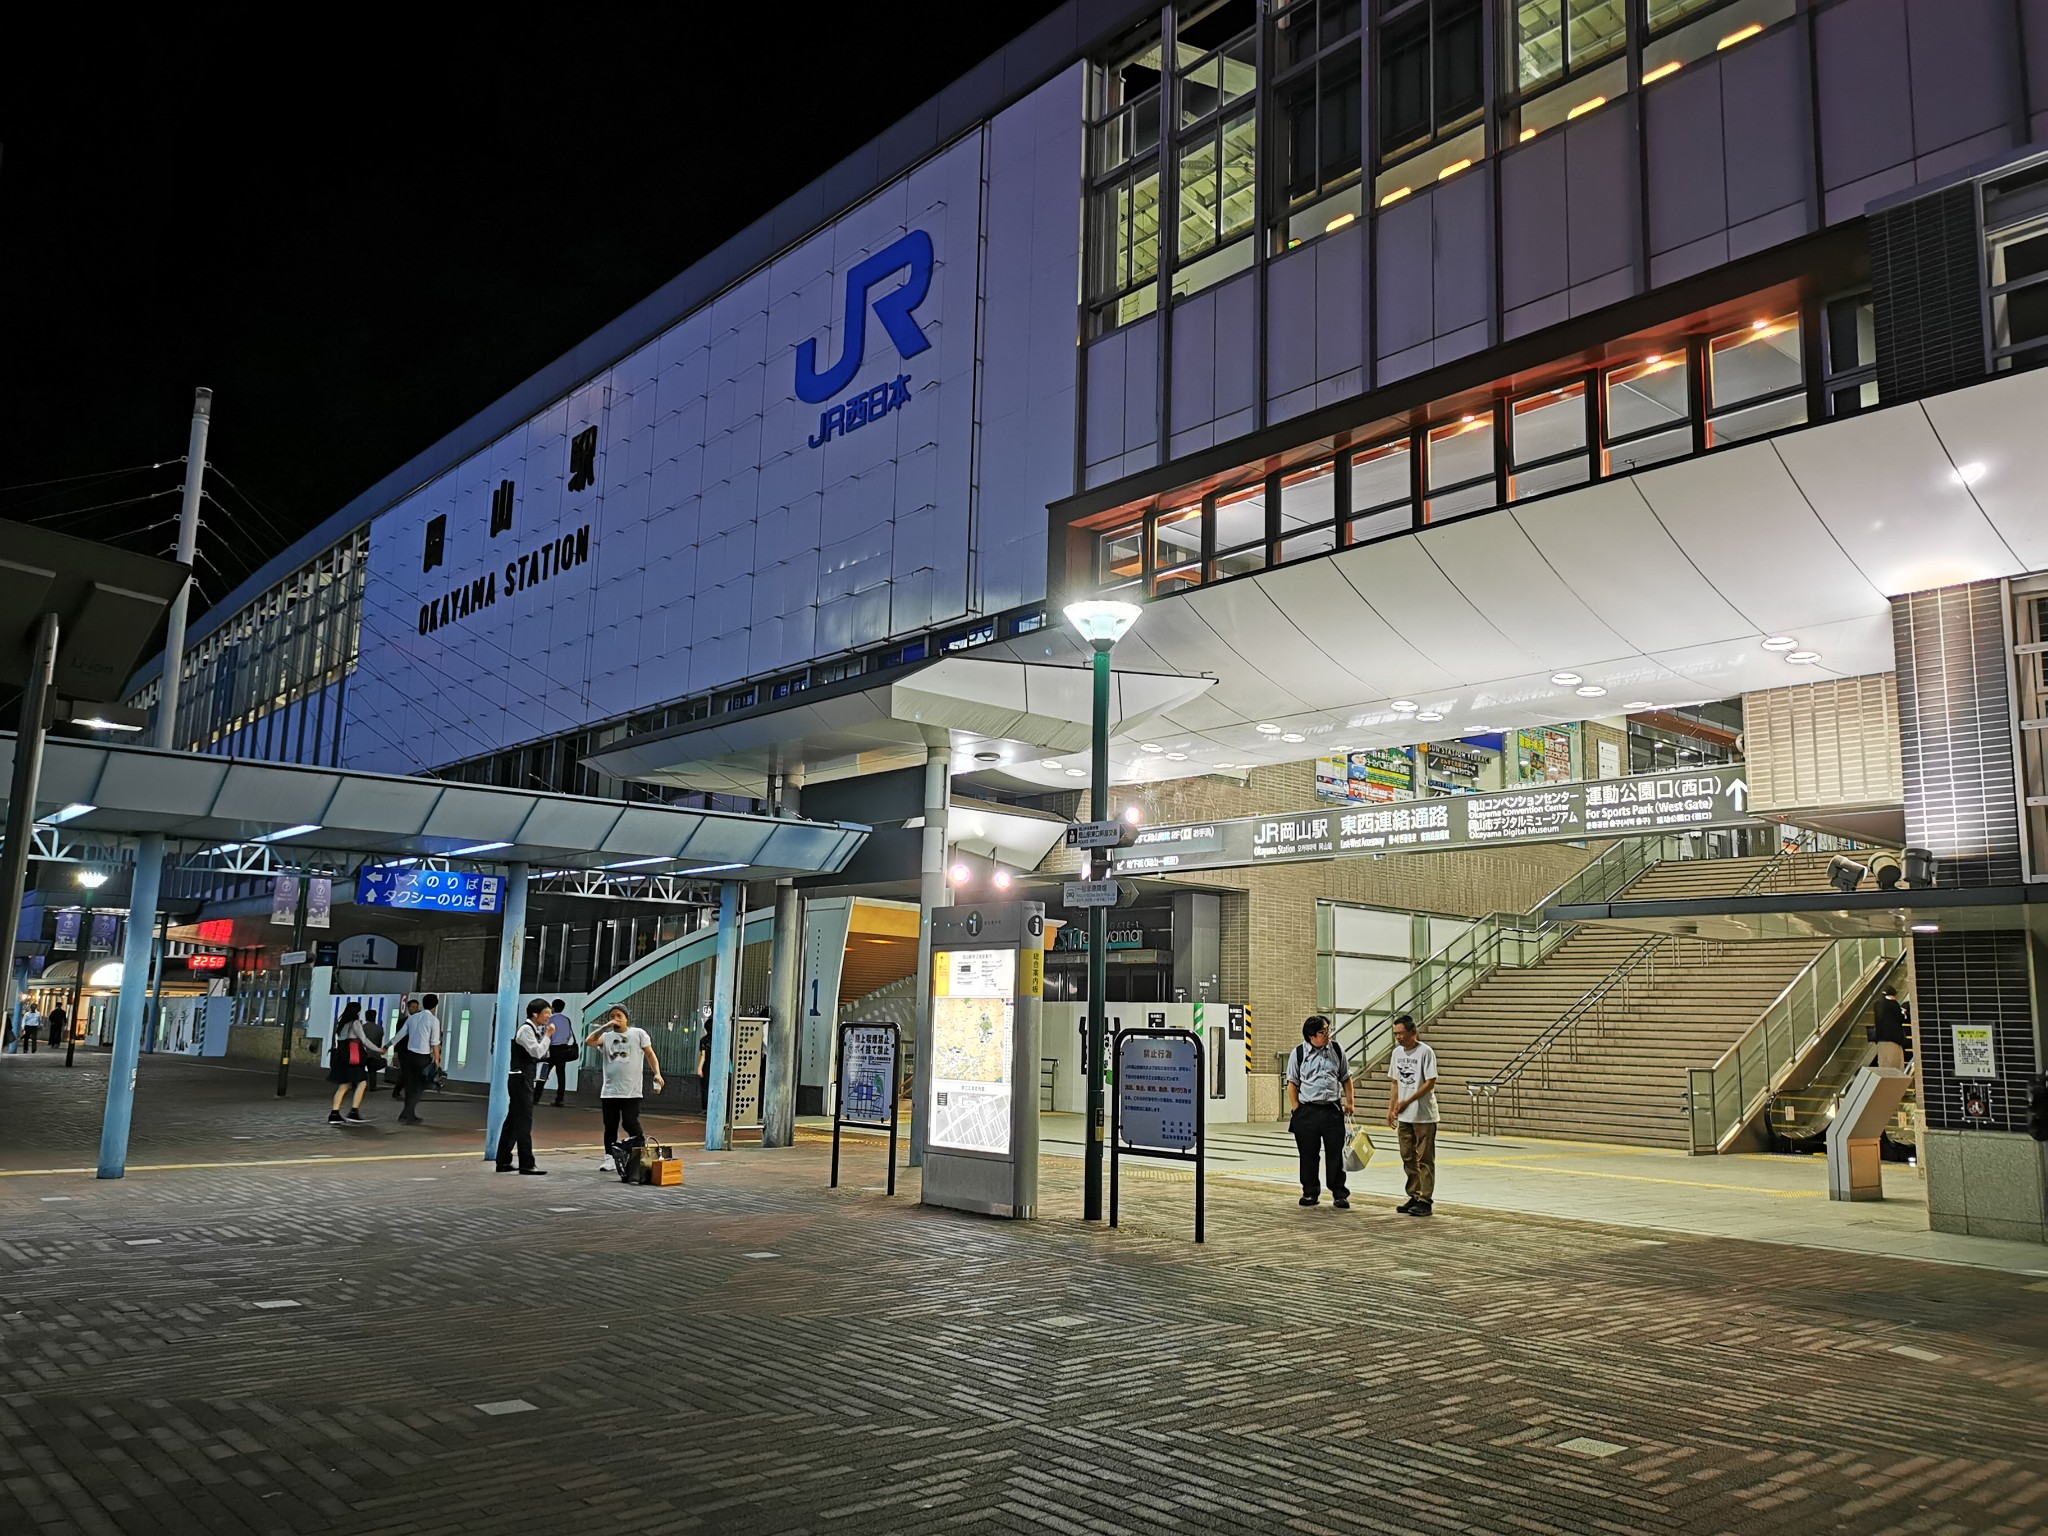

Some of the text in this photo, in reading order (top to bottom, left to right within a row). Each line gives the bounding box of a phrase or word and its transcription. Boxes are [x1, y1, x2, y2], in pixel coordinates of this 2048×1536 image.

[795, 229, 934, 404] JR
[808, 374, 912, 449] JR西日本
[419, 525, 590, 635] OKAYAMA STATION
[1428, 743, 1440, 752] SUN
[1468, 791, 1579, 812] 岡山コンベンションセンター
[1585, 776, 1721, 806] 運動公園口(西口)
[1469, 803, 1570, 820] Okayama Convention Center
[1586, 797, 1713, 819] For Sports Park (West Gate)
[1254, 818, 1328, 844] JR岡山駅
[1340, 805, 1449, 836] 東西連絡通路
[1468, 811, 1578, 832] 岡山市デジタルミュージアム
[1469, 825, 1559, 840] Okayama Digital Museum
[385, 873, 479, 890] バスのりば
[384, 890, 476, 907] タクシーのりば
[1110, 921, 1139, 929] GATE-1
[364, 938, 378, 964] 1
[809, 979, 821, 1016] 1
[1143, 1049, 1172, 1058] 禁止行為
